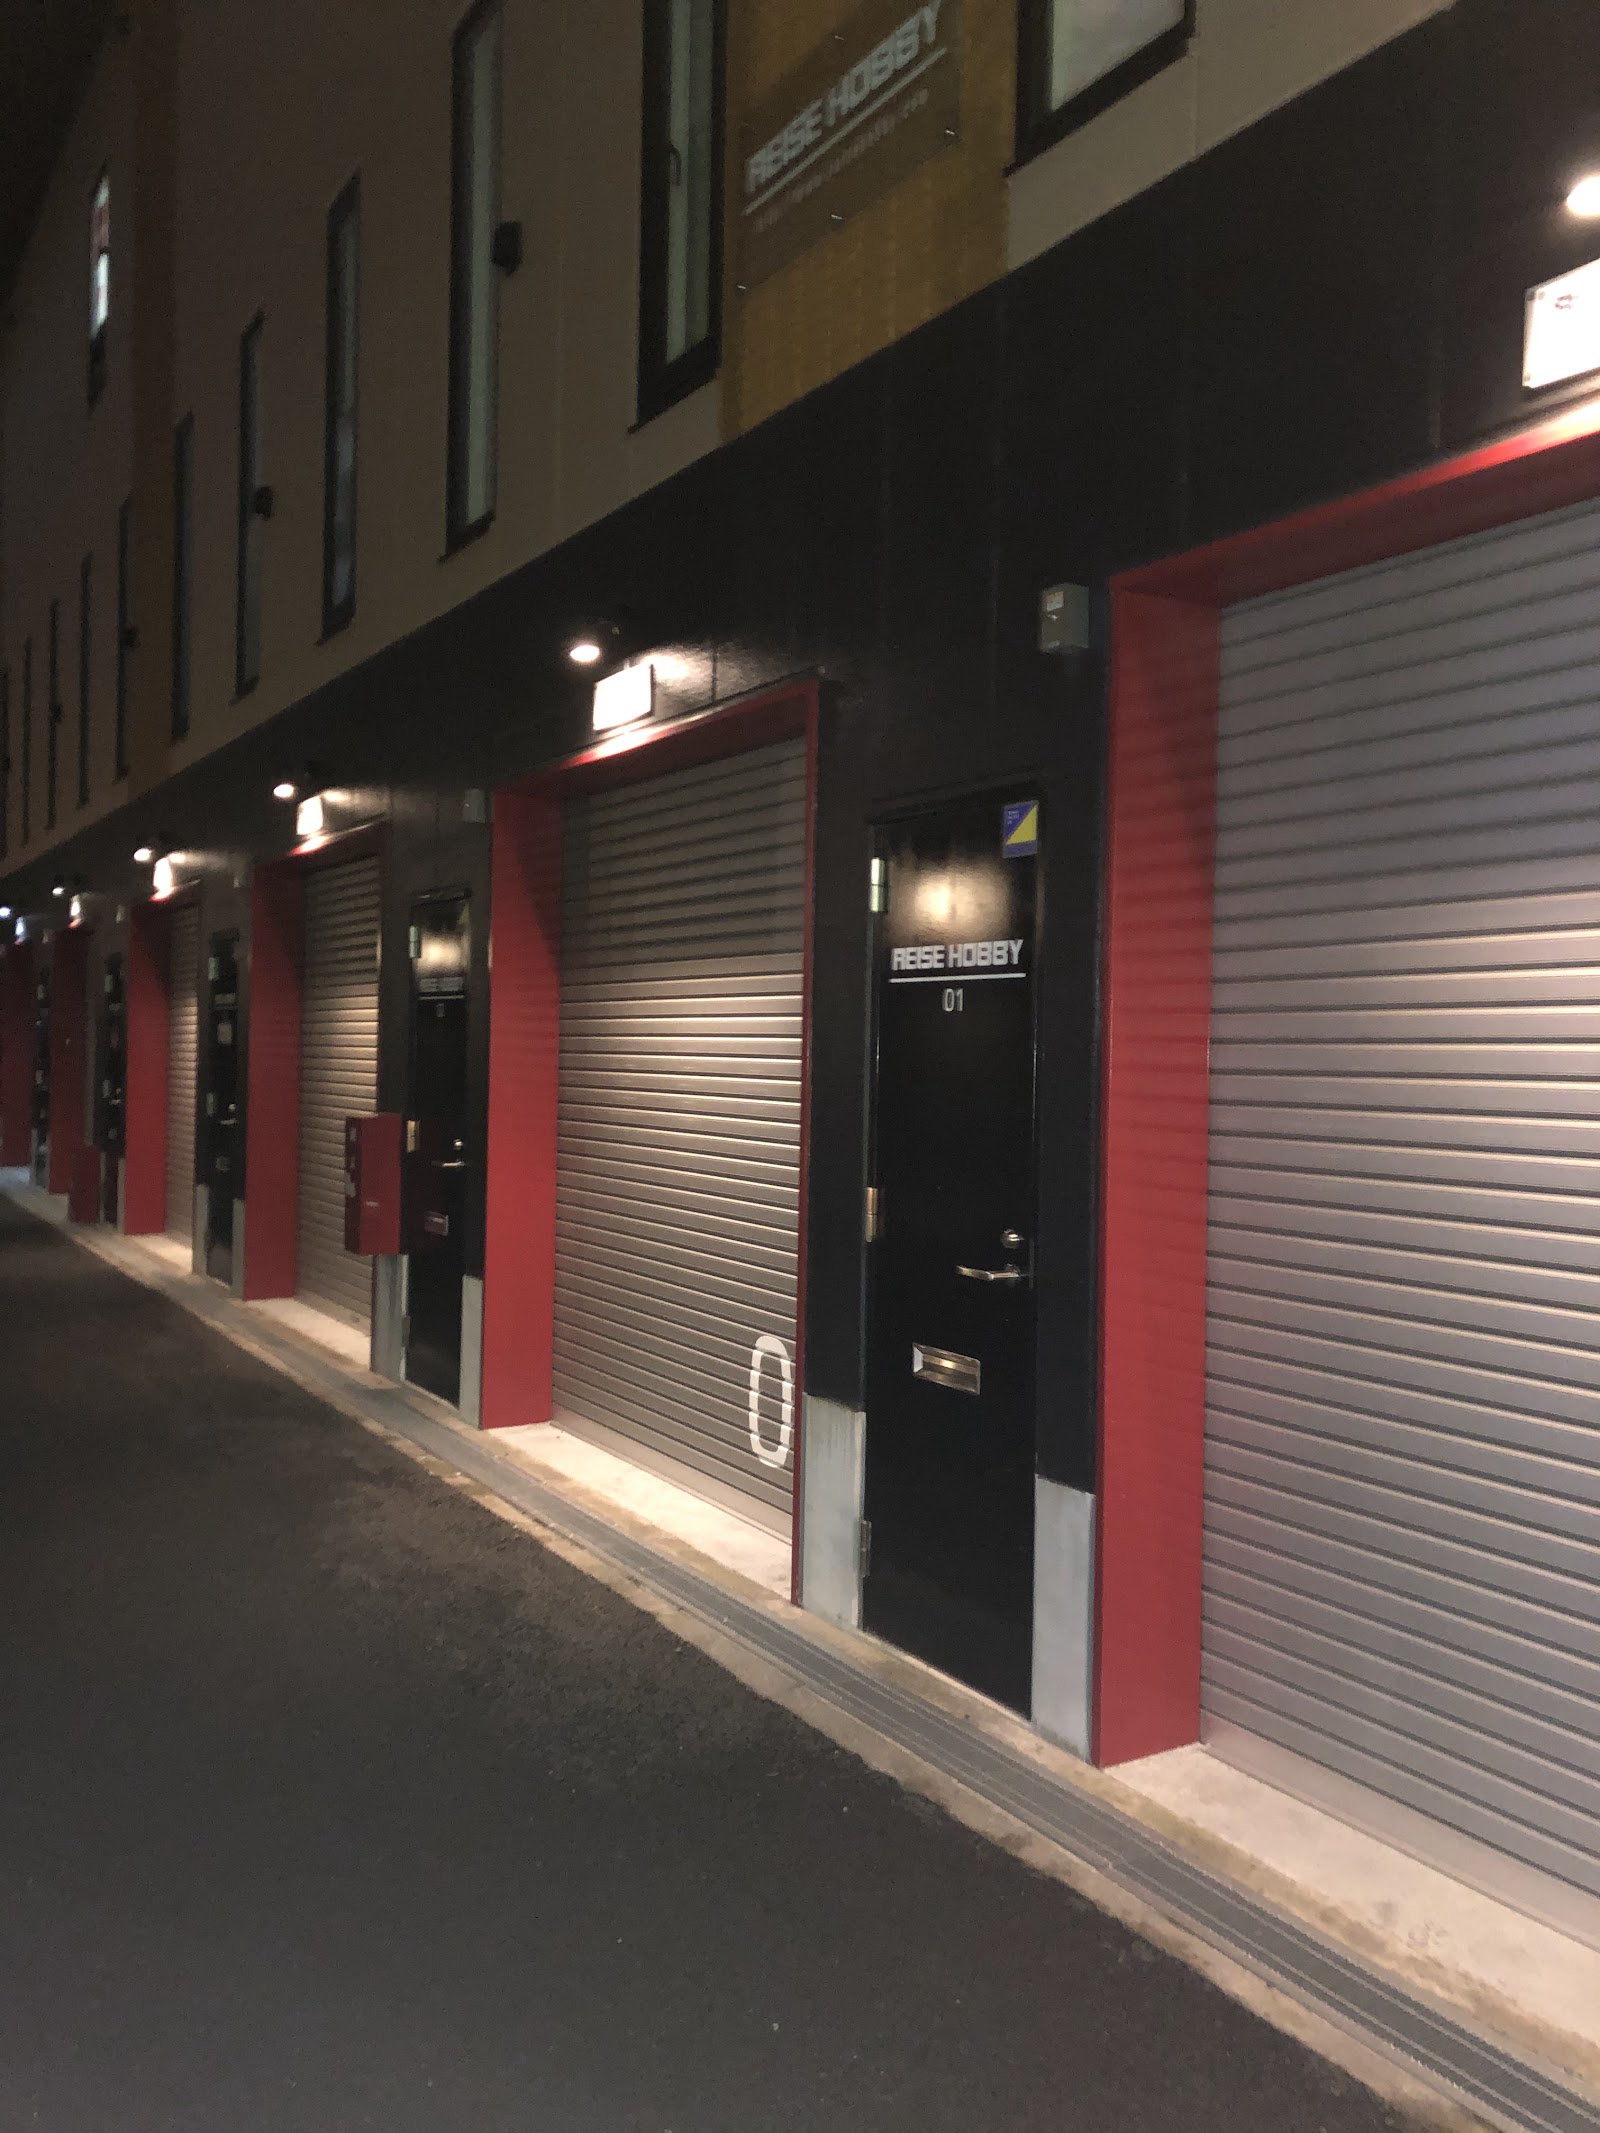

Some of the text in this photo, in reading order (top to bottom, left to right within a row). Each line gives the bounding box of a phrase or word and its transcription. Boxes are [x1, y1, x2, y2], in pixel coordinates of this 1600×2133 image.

[822, 0, 942, 127] HOBBY
[947, 938, 1024, 968] HOBBY
[942, 987, 964, 1012] 01
